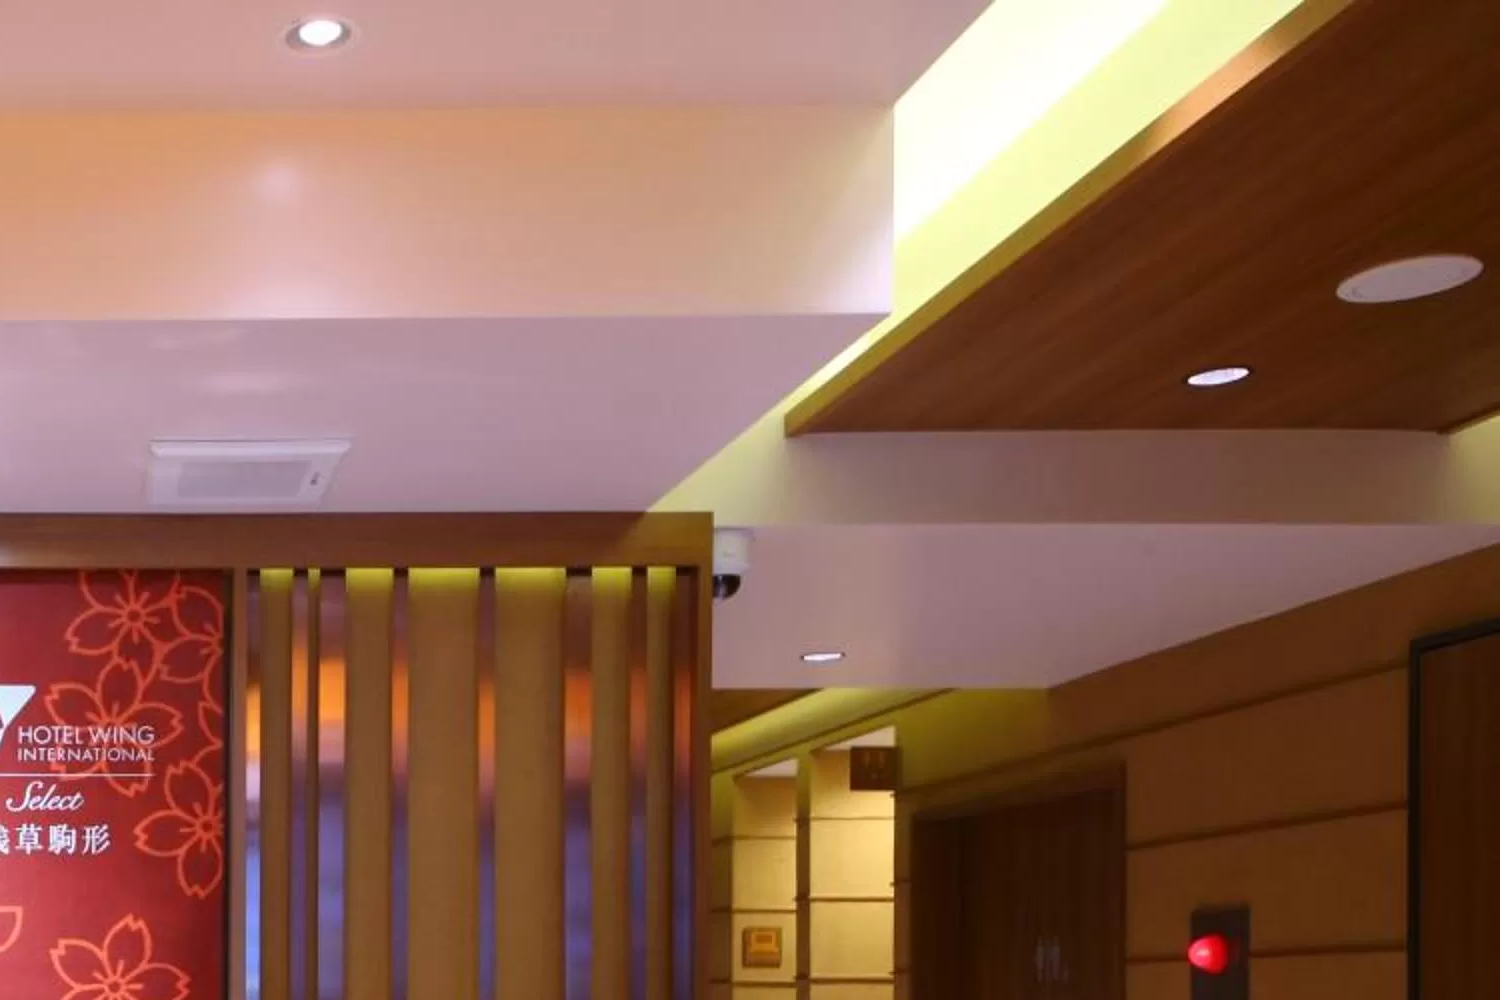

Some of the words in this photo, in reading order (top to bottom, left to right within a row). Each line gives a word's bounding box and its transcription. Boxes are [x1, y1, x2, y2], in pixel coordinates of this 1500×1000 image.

[17, 725, 82, 745] HOTEL
[88, 725, 155, 745] WING
[17, 747, 155, 762] INTERNATIONAL
[5, 780, 84, 812] Select
